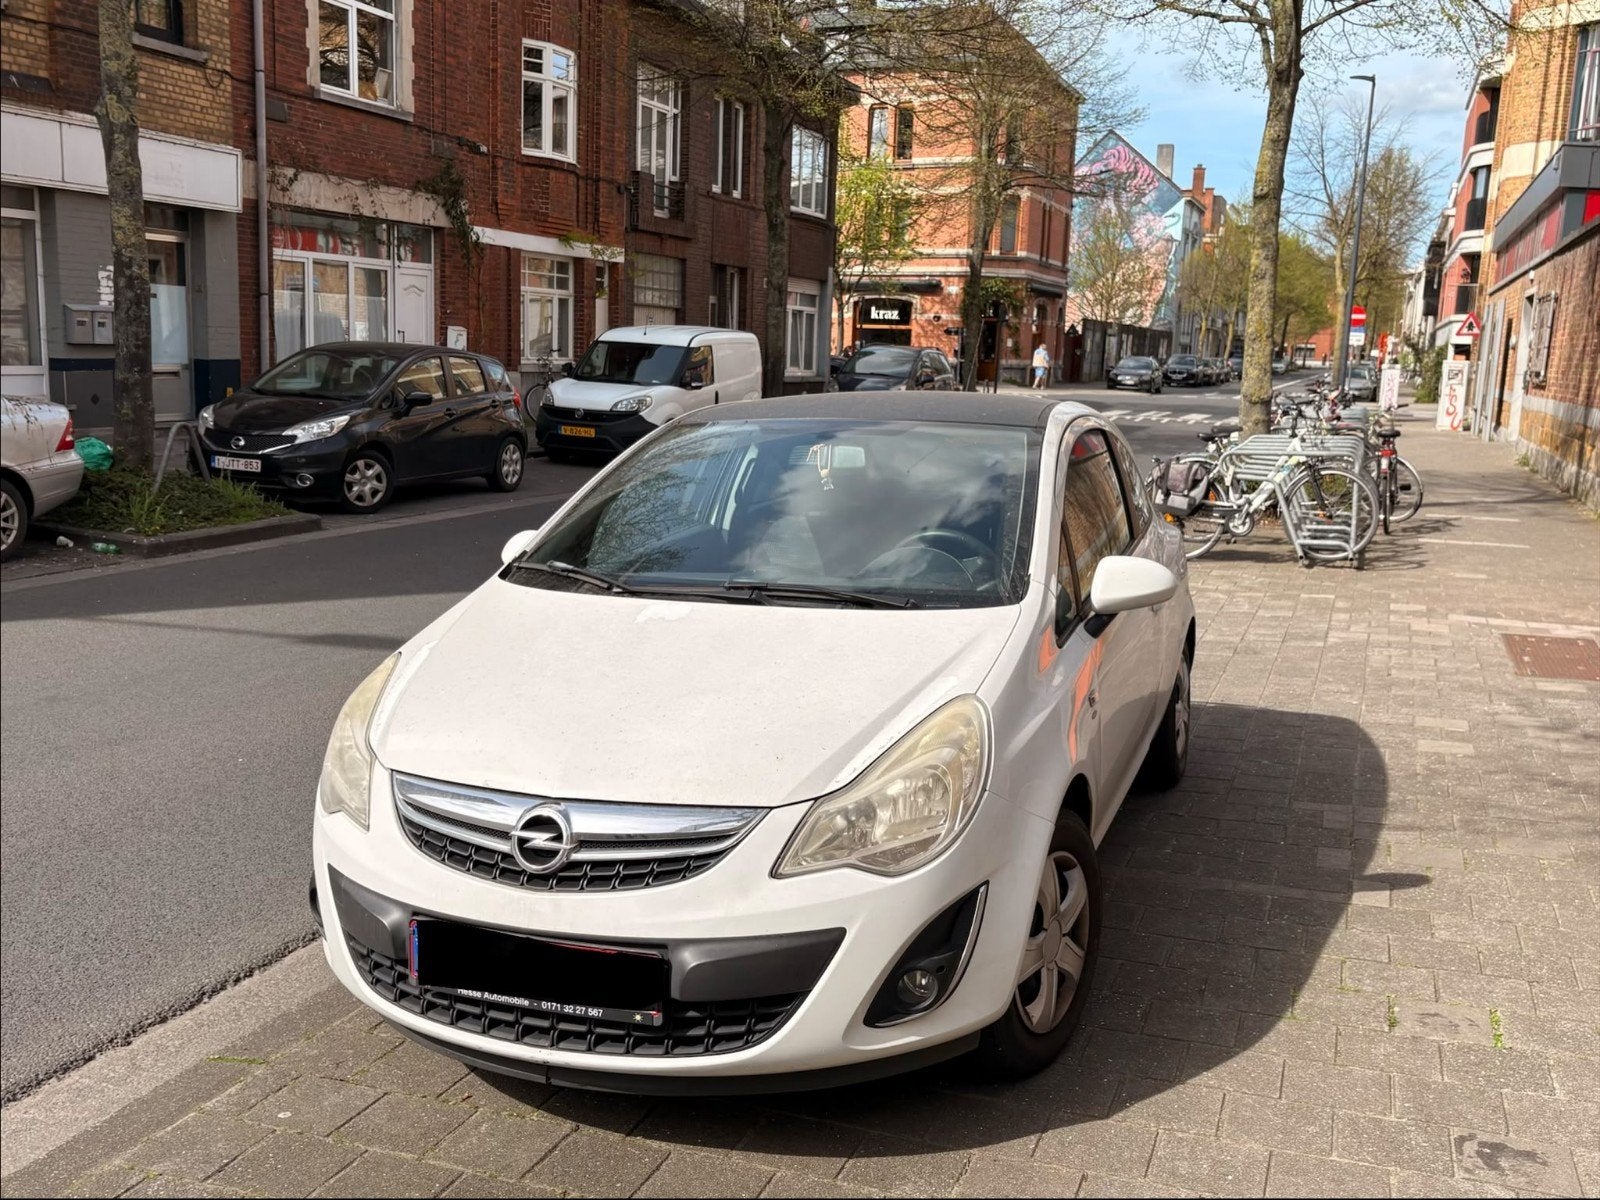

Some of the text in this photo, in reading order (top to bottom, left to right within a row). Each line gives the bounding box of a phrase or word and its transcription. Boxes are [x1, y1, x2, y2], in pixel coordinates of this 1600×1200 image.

[870, 306, 900, 320] kraz
[483, 992, 530, 1006] Automobile
[541, 1001, 561, 1012] 0171
[563, 1004, 574, 1014] 32
[575, 1006, 586, 1015] 27
[588, 1008, 604, 1018] 567
